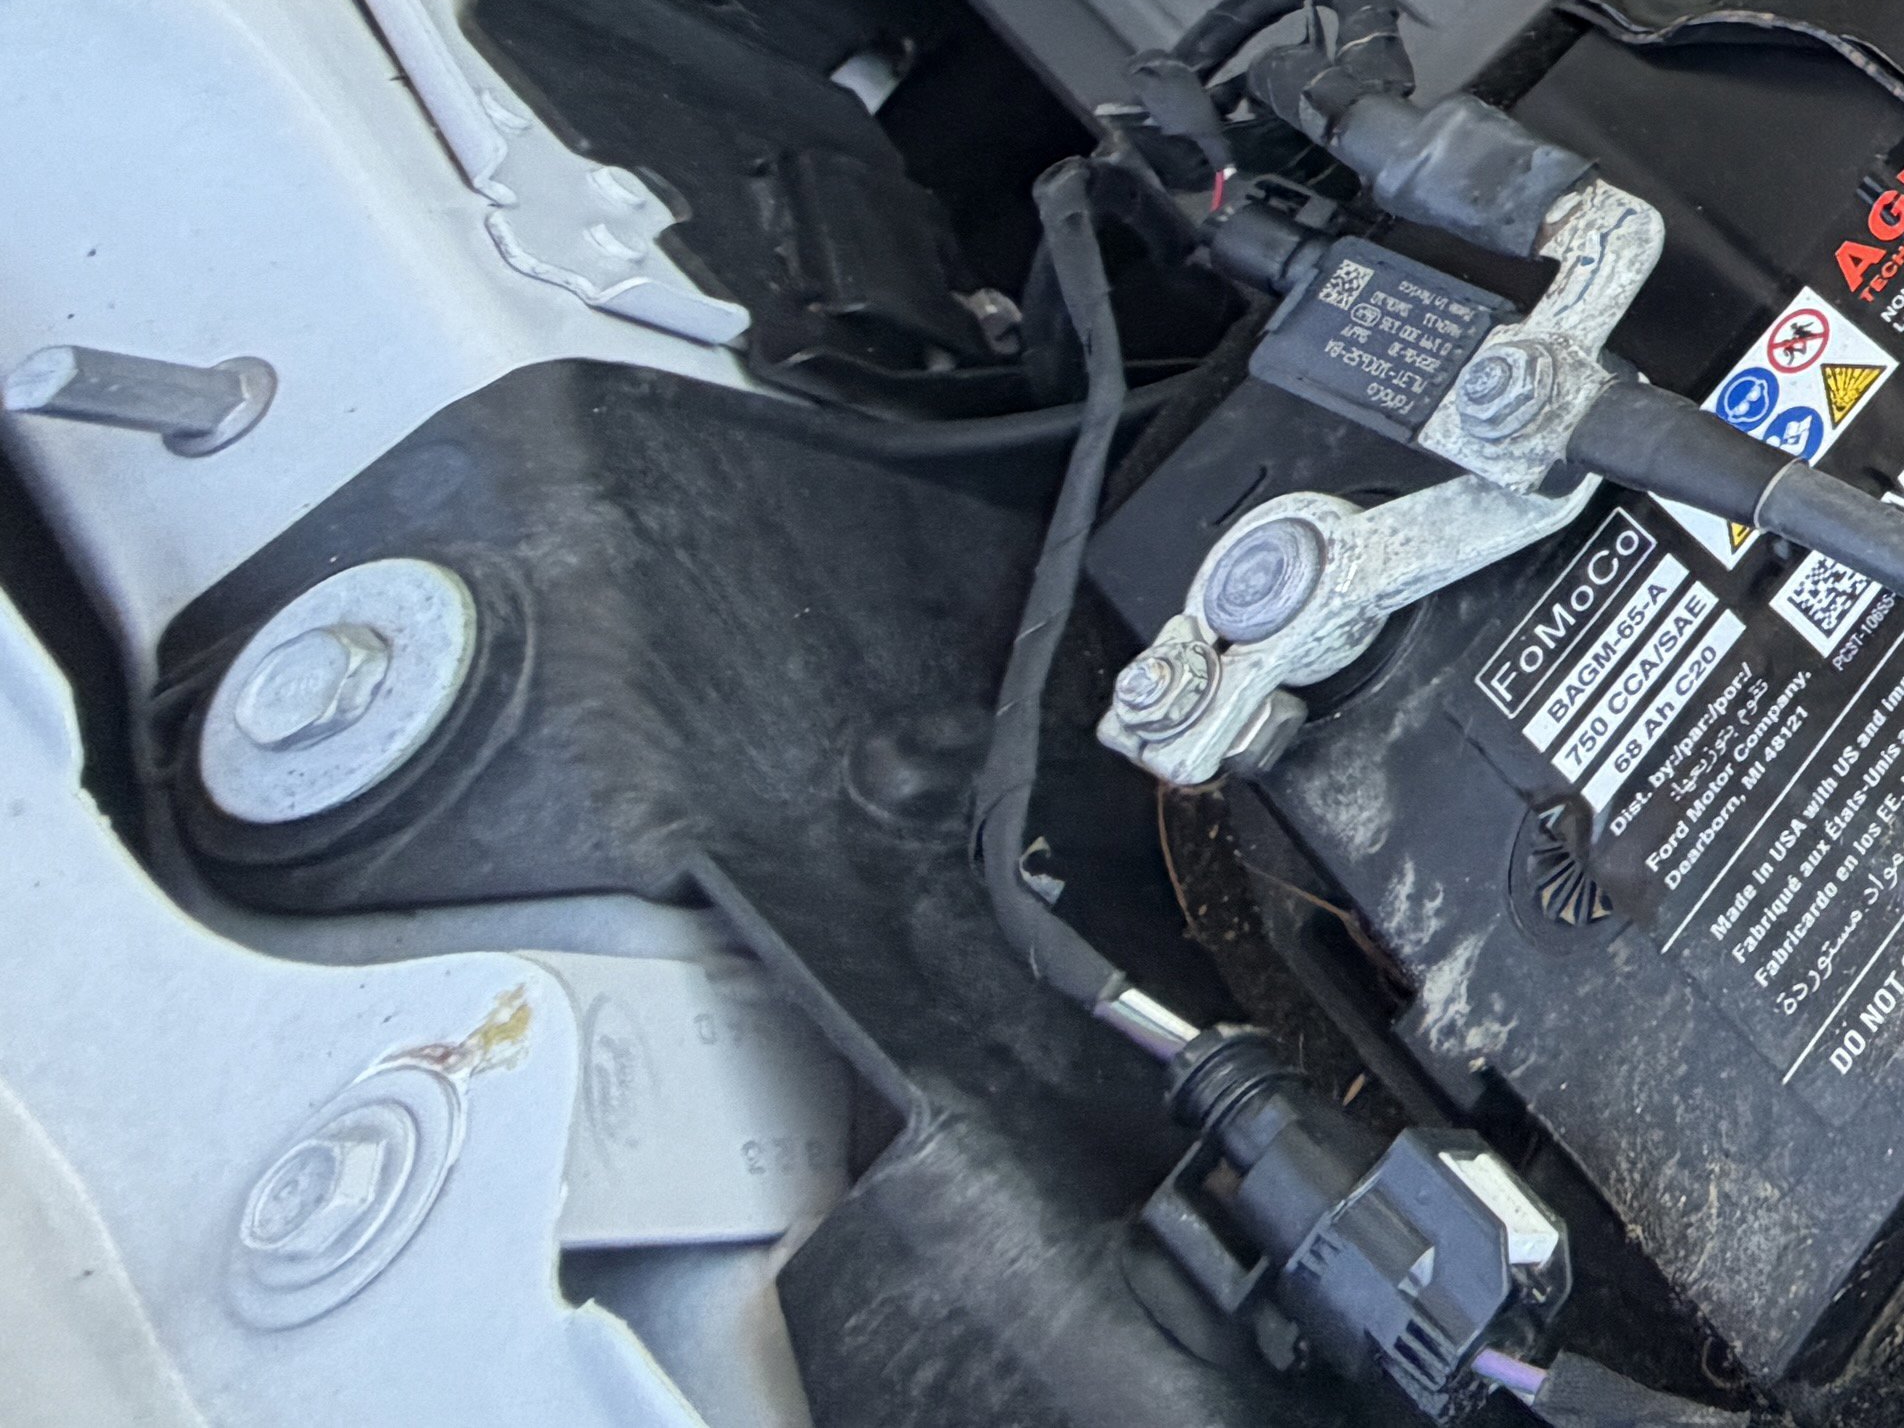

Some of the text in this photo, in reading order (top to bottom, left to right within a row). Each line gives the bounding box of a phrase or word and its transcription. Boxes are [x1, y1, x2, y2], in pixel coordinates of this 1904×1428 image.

[1490, 530, 1639, 701] FoMoCo
[1547, 584, 1666, 722] BAGM-65-A
[1564, 594, 1706, 765] 750 CCA/SAE
[1613, 645, 1716, 773] 68 Ah C20
[1644, 671, 1811, 872] Ford Motor Company.
[1609, 791, 1652, 836] Dist.
[1664, 705, 1808, 890] Dearborn, MI 48121
[1709, 884, 1756, 940] Made
[1751, 861, 1774, 884] in
[1768, 818, 1807, 861] USA
[1802, 776, 1838, 819] with
[1832, 745, 1859, 776] US
[1856, 708, 1886, 748] and
[1731, 874, 1801, 963] Fabriqué
[1799, 839, 1830, 877] aux
[1824, 743, 1900, 840] États-Unis
[1754, 881, 1837, 987] Fabricardo
[1835, 854, 1858, 881] en
[1852, 822, 1881, 855] los
[1875, 792, 1904, 823] EE.
[1829, 1029, 1866, 1074] DO
[1859, 970, 1904, 1032] NOT
